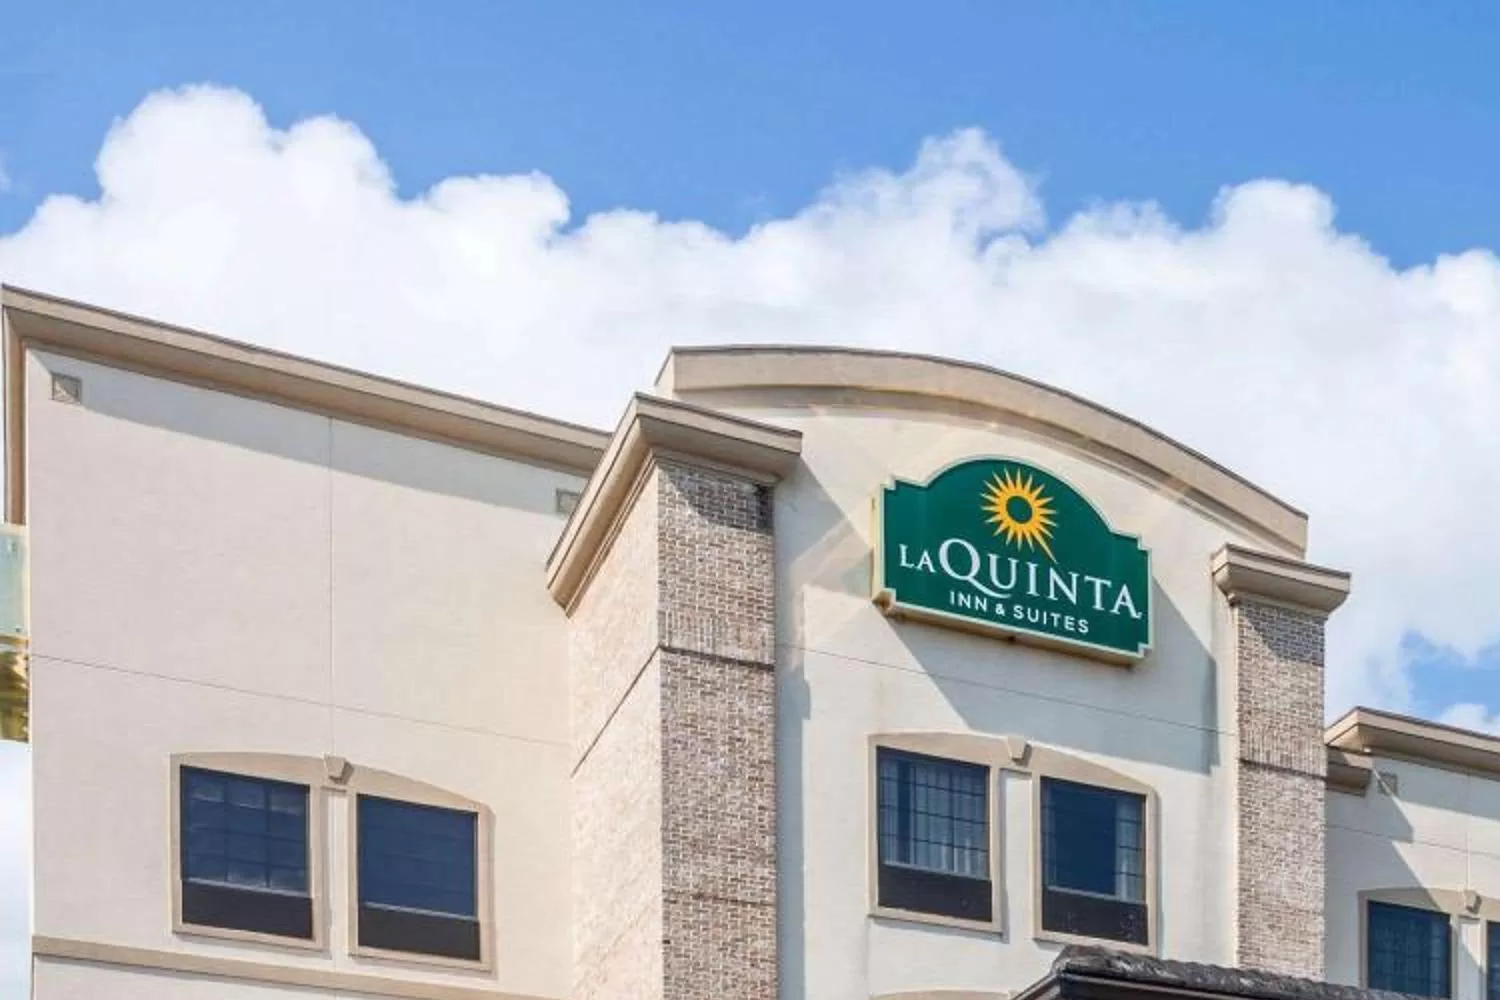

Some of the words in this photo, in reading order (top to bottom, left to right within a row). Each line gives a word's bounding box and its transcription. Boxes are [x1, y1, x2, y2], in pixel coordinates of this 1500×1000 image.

[899, 543, 936, 573] LA
[939, 538, 1143, 619] QUINTA
[950, 591, 987, 612] INN
[995, 603, 1006, 617] &
[1013, 605, 1089, 633] SUITES
